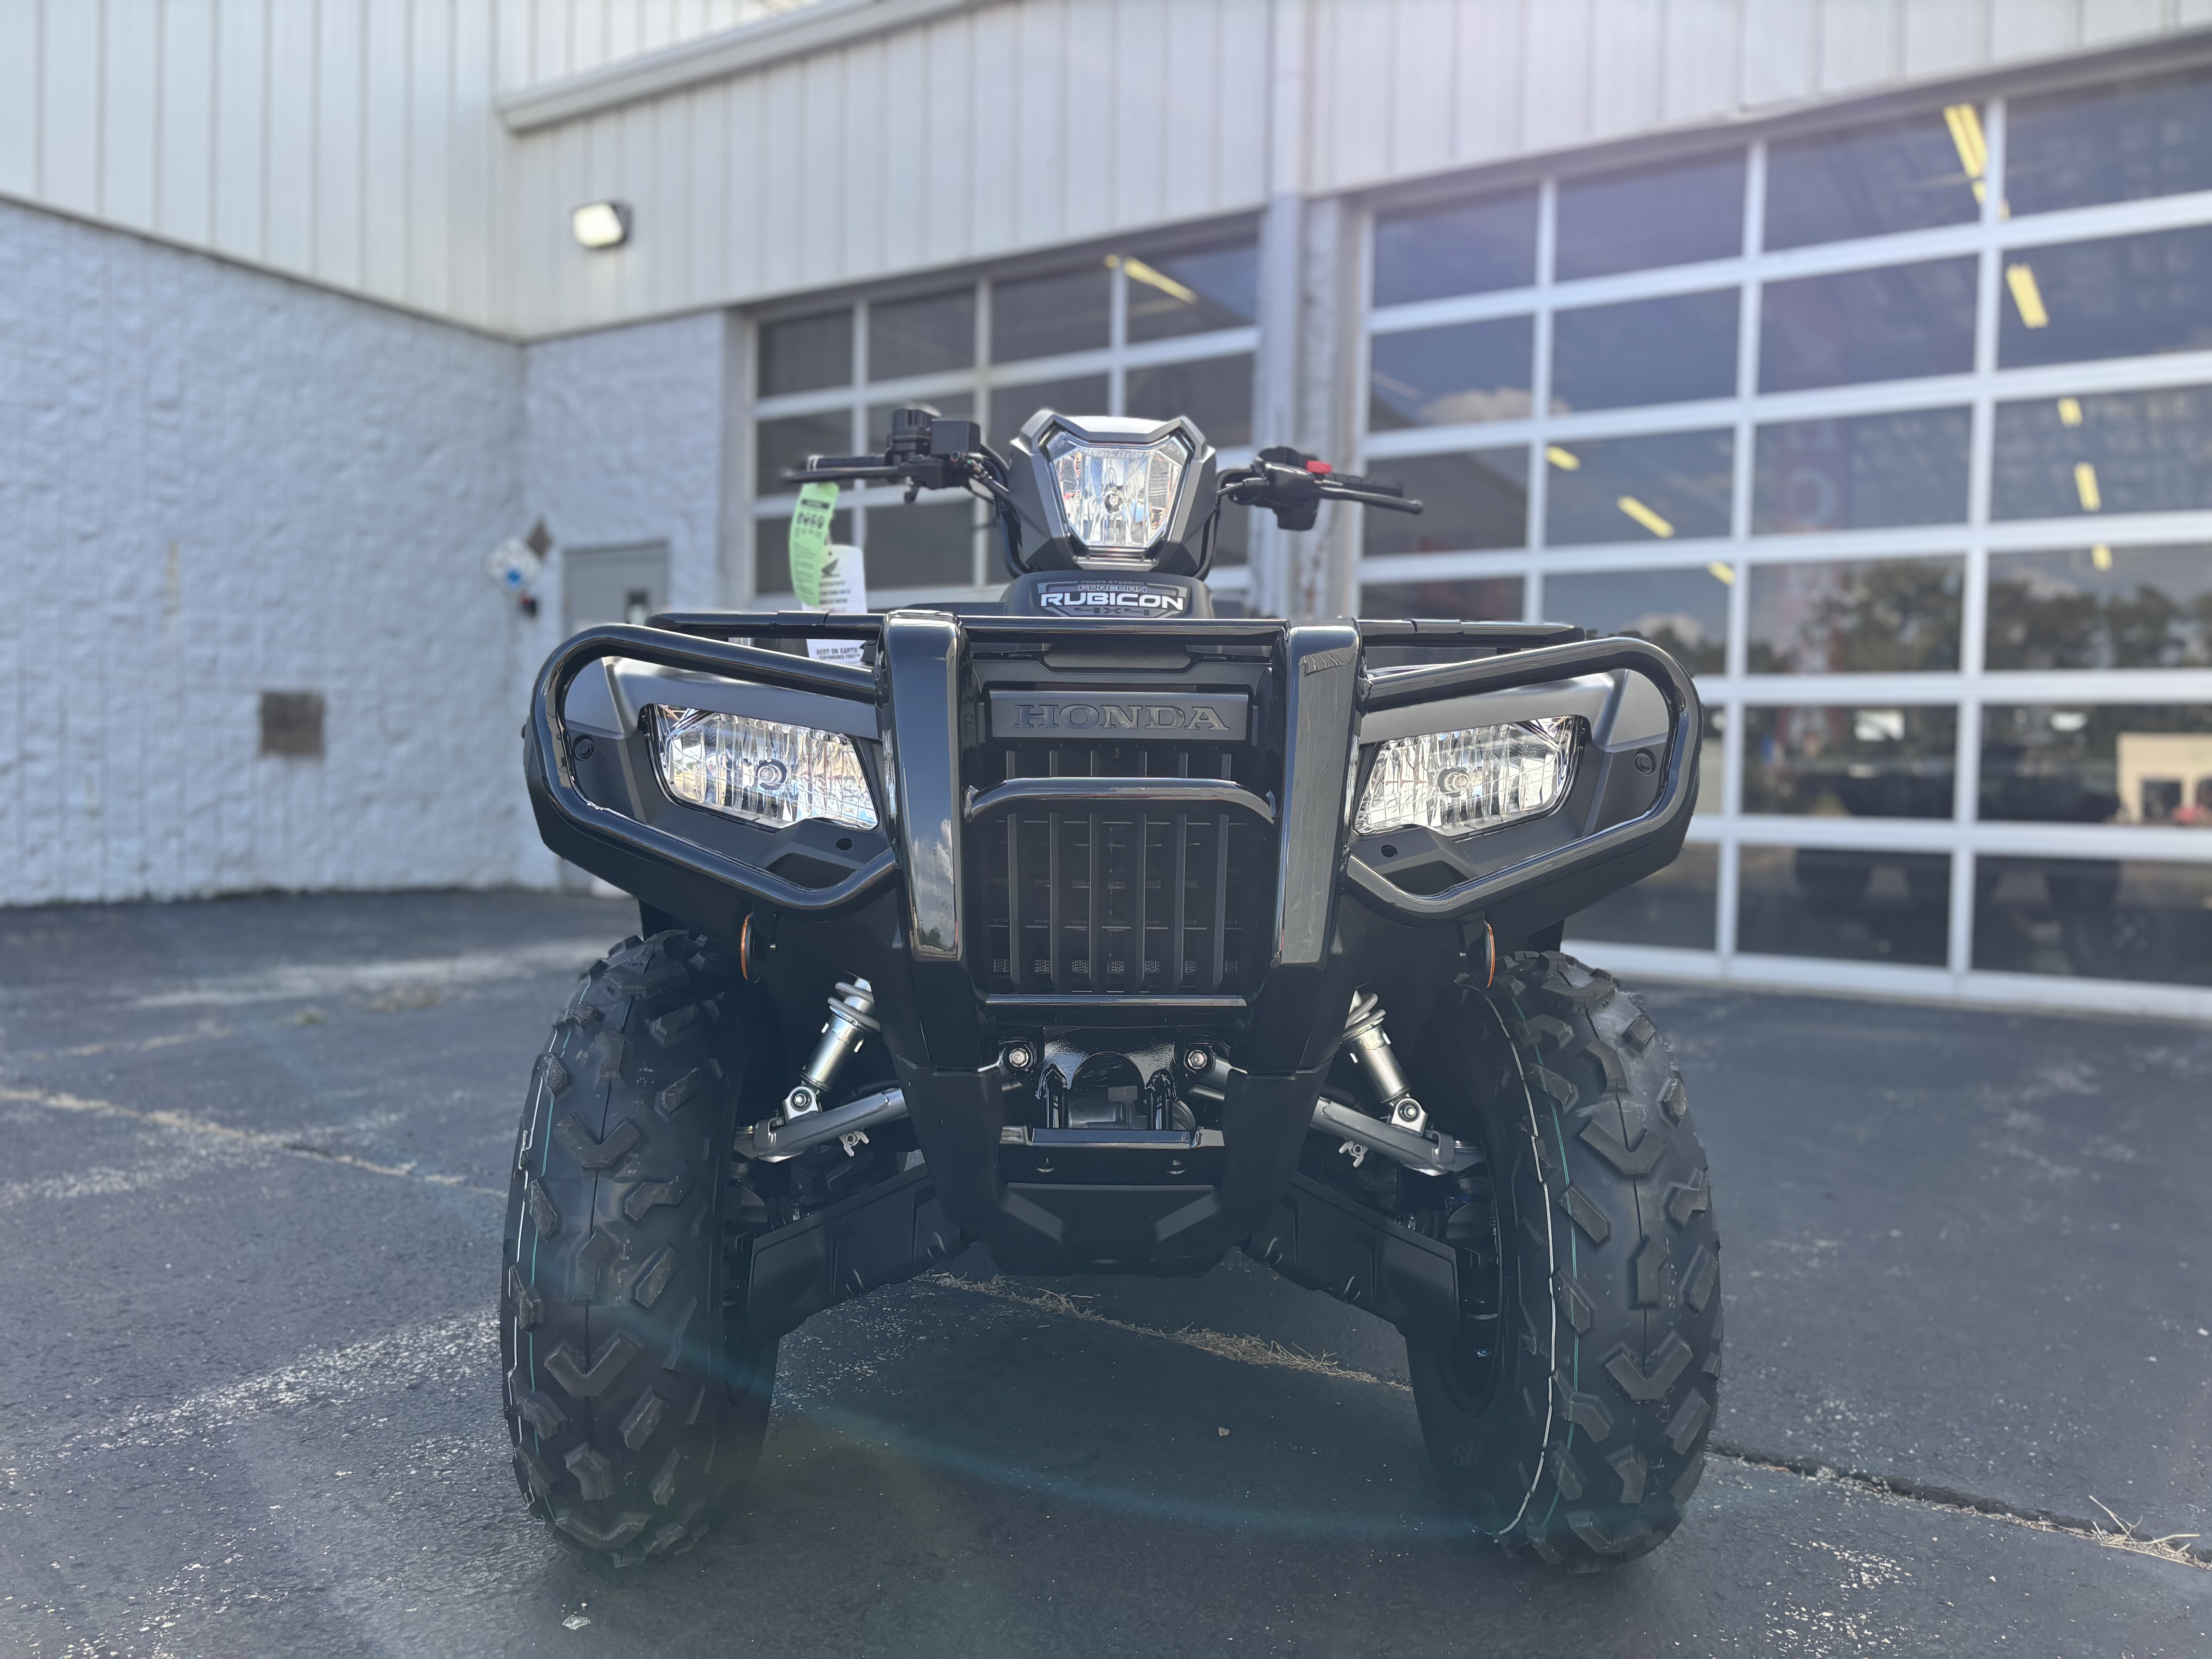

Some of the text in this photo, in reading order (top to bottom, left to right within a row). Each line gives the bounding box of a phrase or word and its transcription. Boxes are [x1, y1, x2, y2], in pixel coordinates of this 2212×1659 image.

[1078, 584, 1147, 593] FOREMAN
[1041, 592, 1183, 611] RUBICON
[1013, 704, 1230, 731] HONDA
